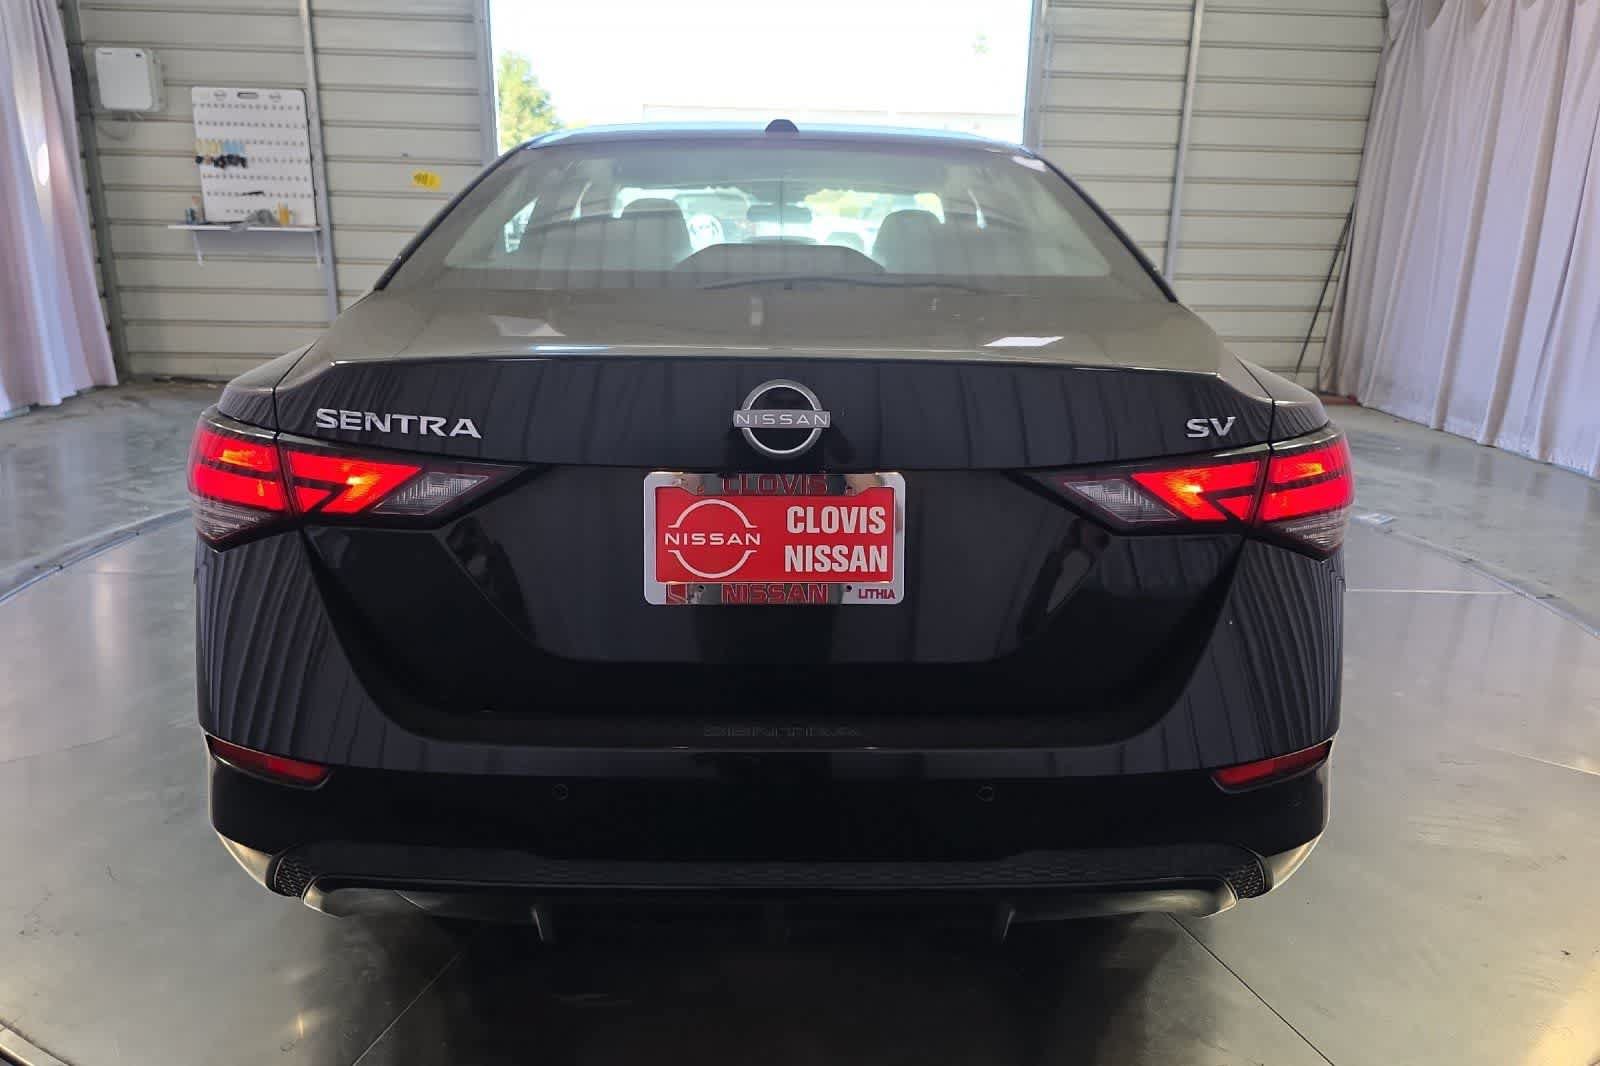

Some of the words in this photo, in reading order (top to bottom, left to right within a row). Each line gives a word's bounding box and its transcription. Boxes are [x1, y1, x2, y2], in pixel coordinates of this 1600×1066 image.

[316, 408, 482, 439] SENTRA
[736, 413, 828, 425] NISSAN
[1186, 416, 1236, 438] SV
[786, 505, 886, 534] CLOVIS
[664, 532, 760, 546] NISSAN
[784, 544, 888, 573] NISSAN
[721, 583, 828, 605] NISSAN
[858, 588, 896, 600] LITHIA
